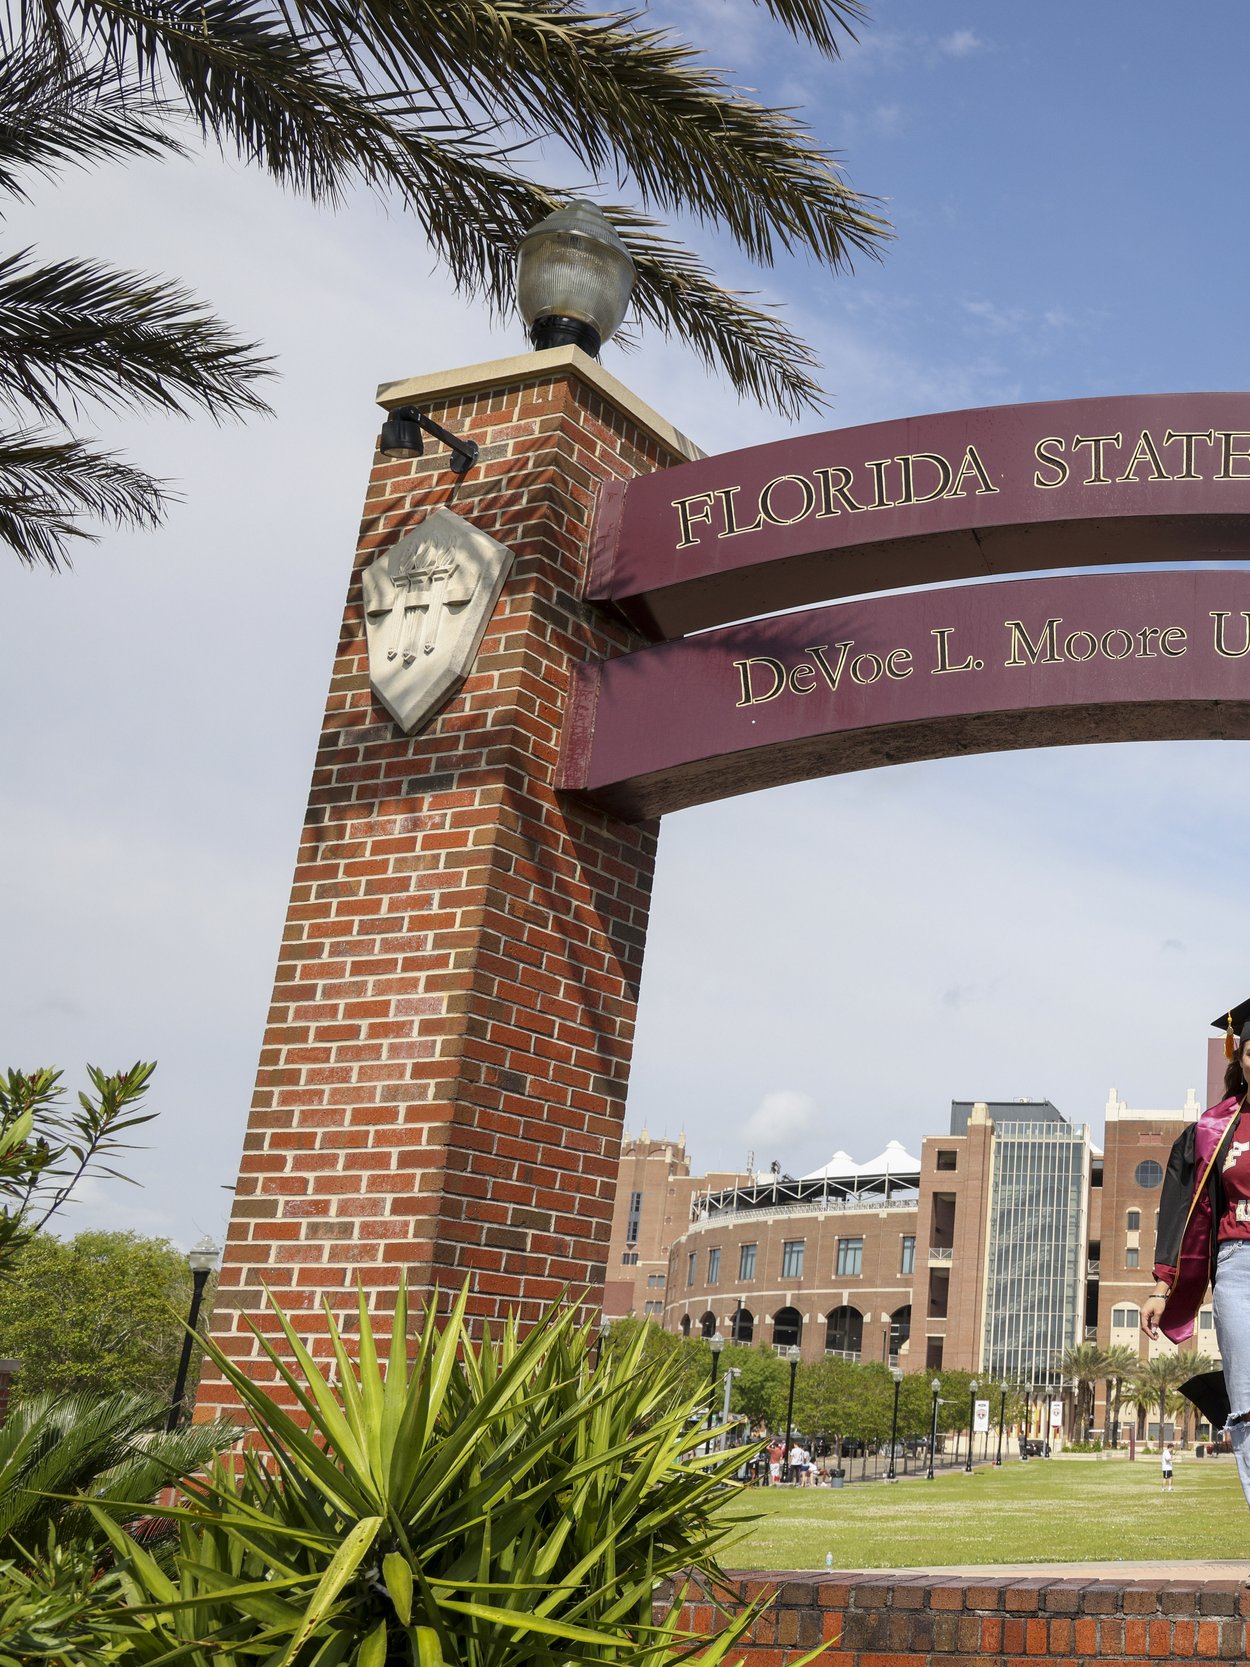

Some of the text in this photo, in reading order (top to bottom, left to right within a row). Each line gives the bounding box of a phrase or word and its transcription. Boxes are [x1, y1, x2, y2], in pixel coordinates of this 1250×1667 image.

[671, 445, 999, 549] FLORIDA
[733, 640, 914, 708] DeVoe
[931, 627, 985, 675] L.
[1004, 617, 1188, 667] Moore
